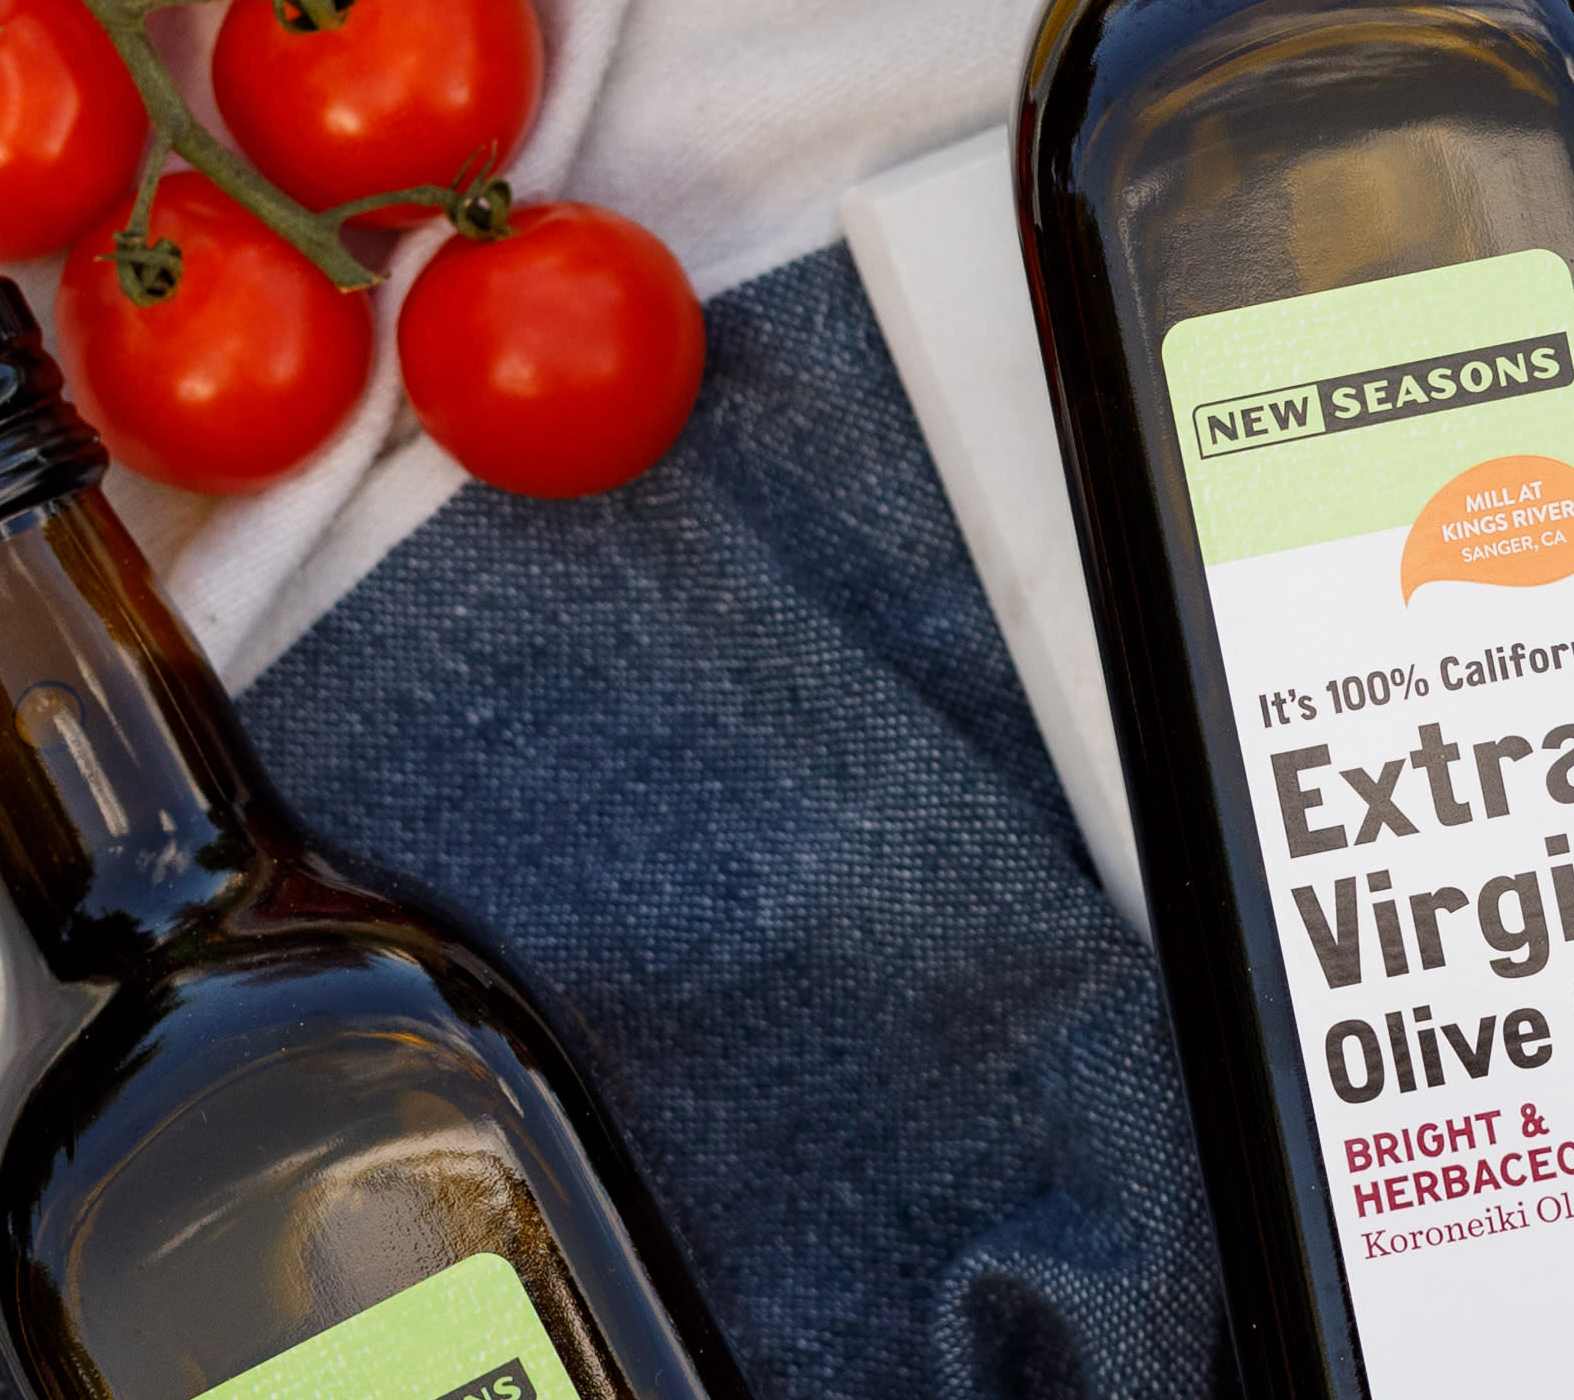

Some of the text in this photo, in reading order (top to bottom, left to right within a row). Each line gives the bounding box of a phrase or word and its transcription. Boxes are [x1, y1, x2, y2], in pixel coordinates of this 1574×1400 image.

[1207, 346, 1562, 446] NEW SEASONS
[1466, 481, 1542, 513] MILL AT
[1442, 513, 1508, 542] KINGS
[1462, 530, 1567, 562] SANGER, CA
[1259, 689, 1316, 728] It's
[1327, 665, 1428, 712] 100%
[1326, 1004, 1553, 1103] Olive
[1344, 1102, 1550, 1173] BRIGHT &
[1362, 1203, 1530, 1259] Koroneiki
